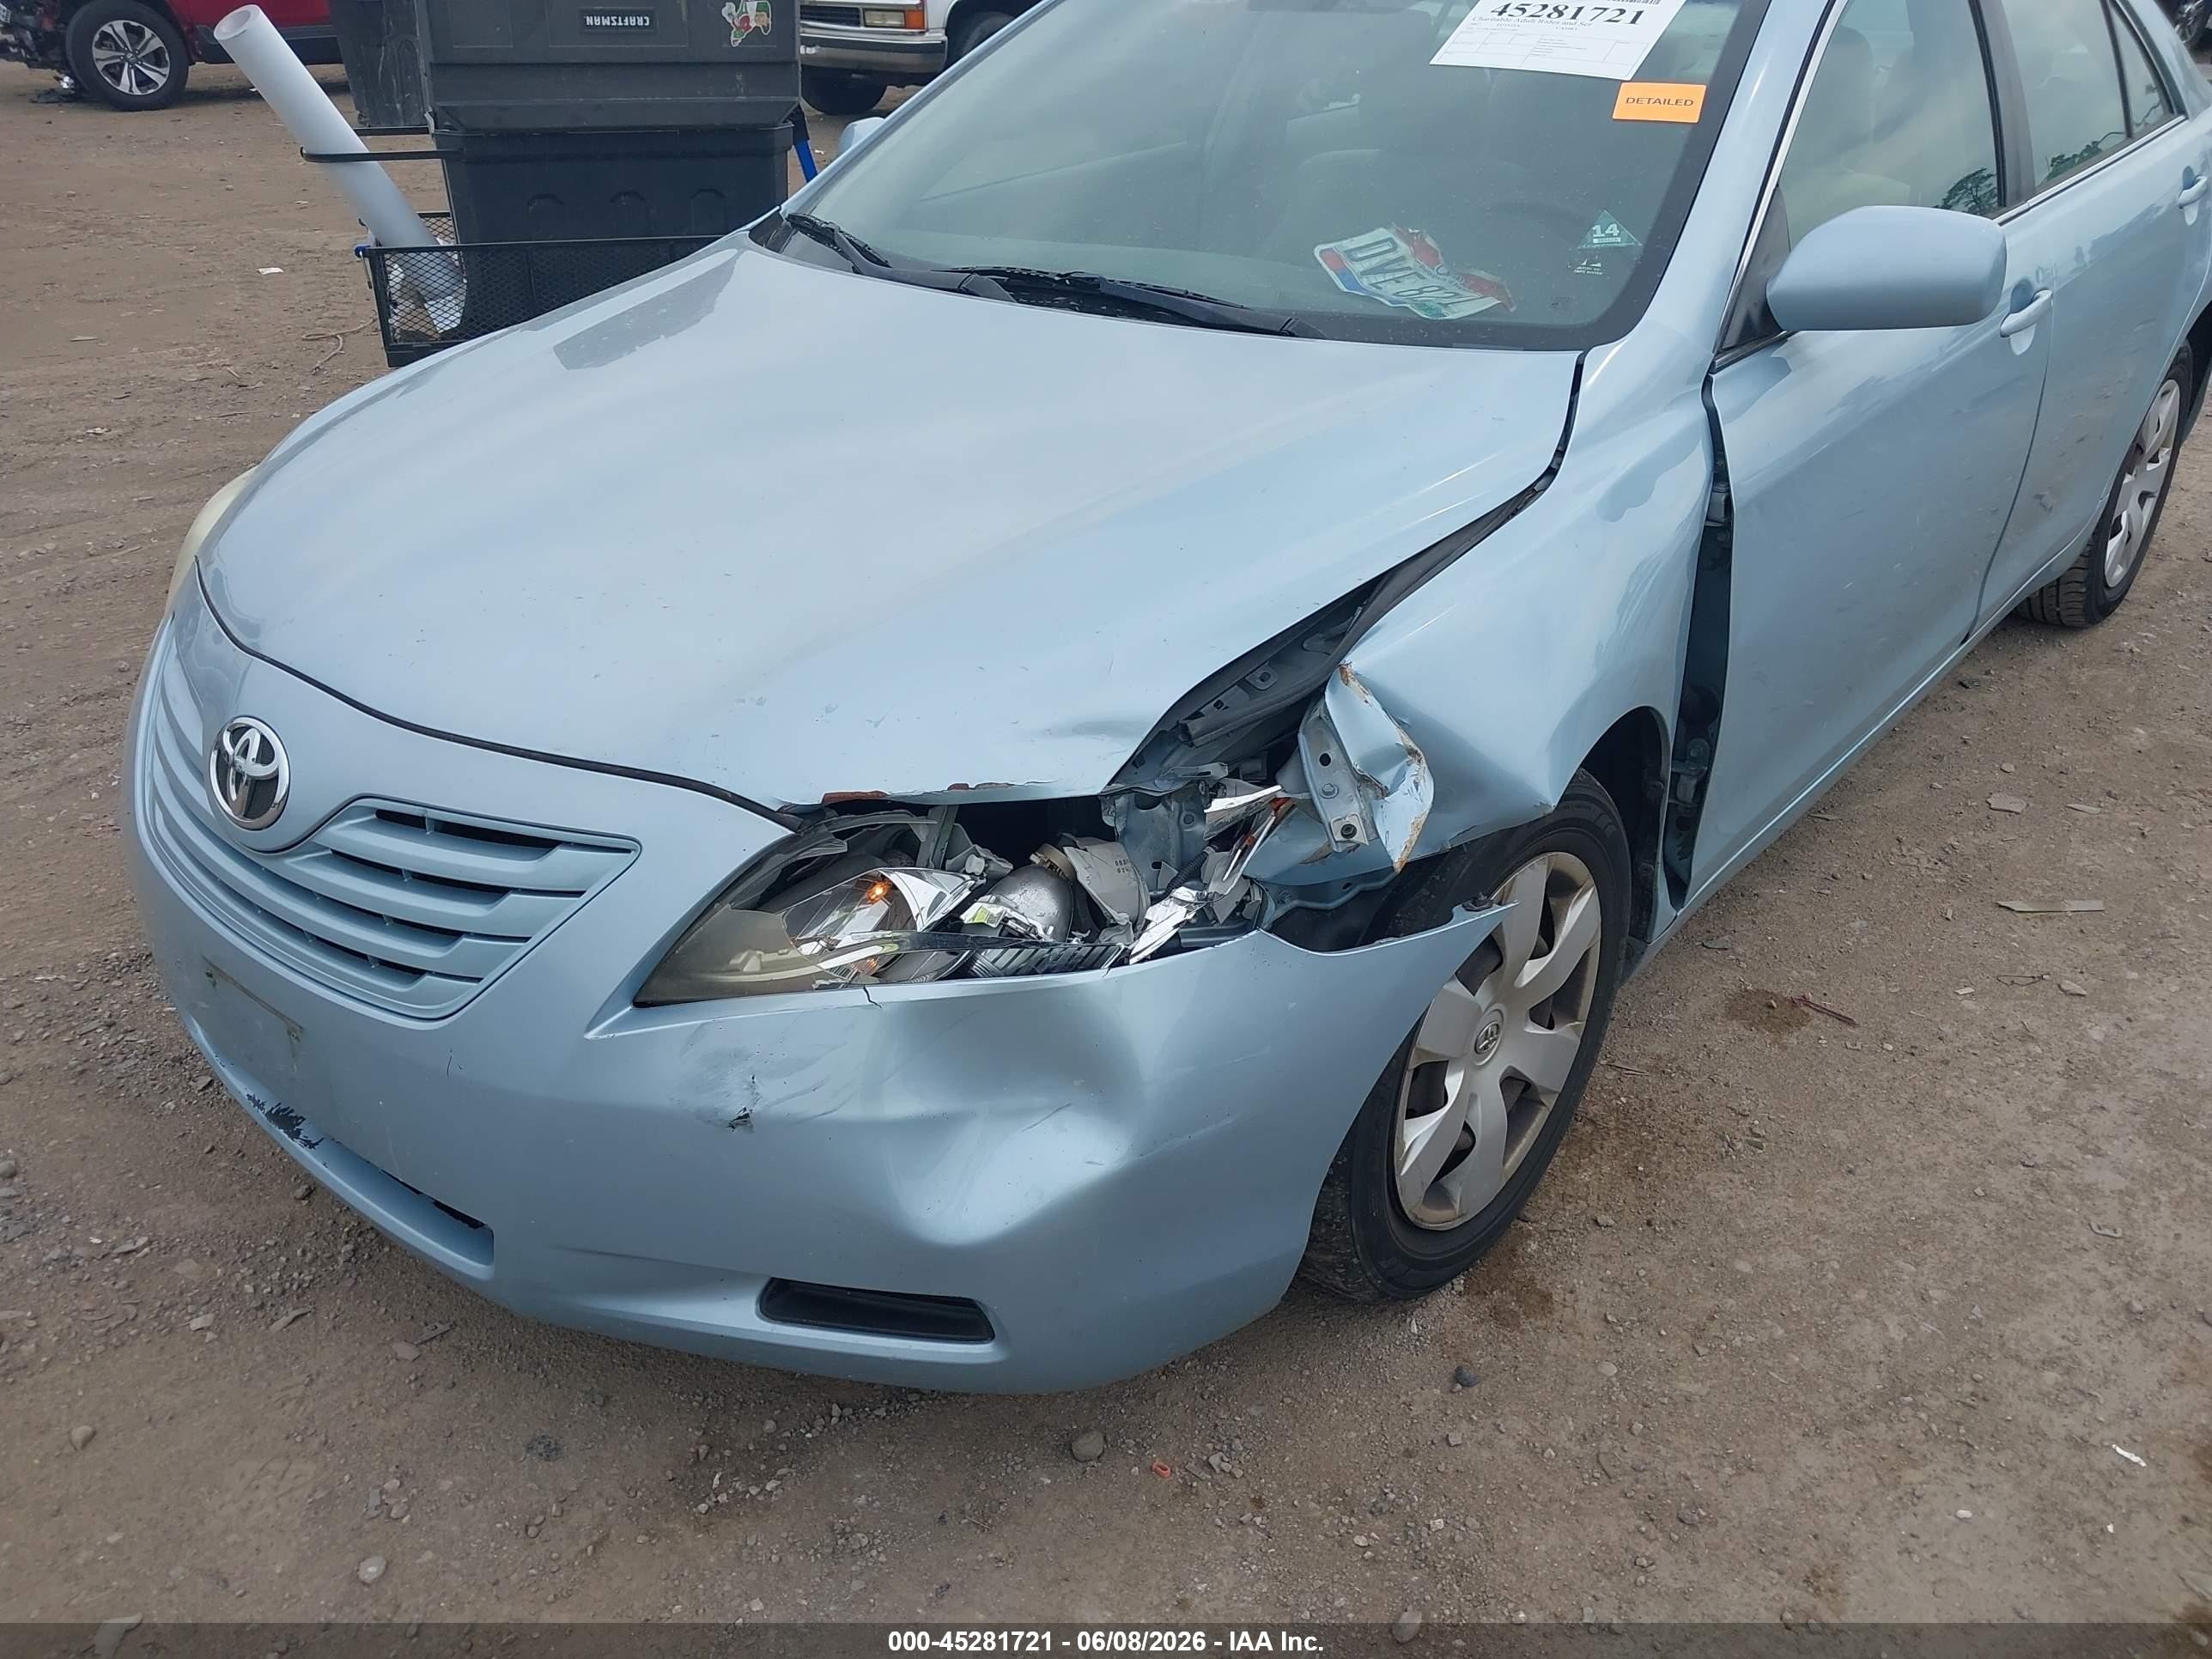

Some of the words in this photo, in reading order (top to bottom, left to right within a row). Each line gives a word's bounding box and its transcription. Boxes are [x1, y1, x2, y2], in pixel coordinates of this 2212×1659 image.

[586, 15, 649, 27] CRAFTSMAN
[1491, 3, 1644, 26] 45281721
[1626, 97, 1694, 107] DETAILED
[1592, 223, 1620, 237] 14
